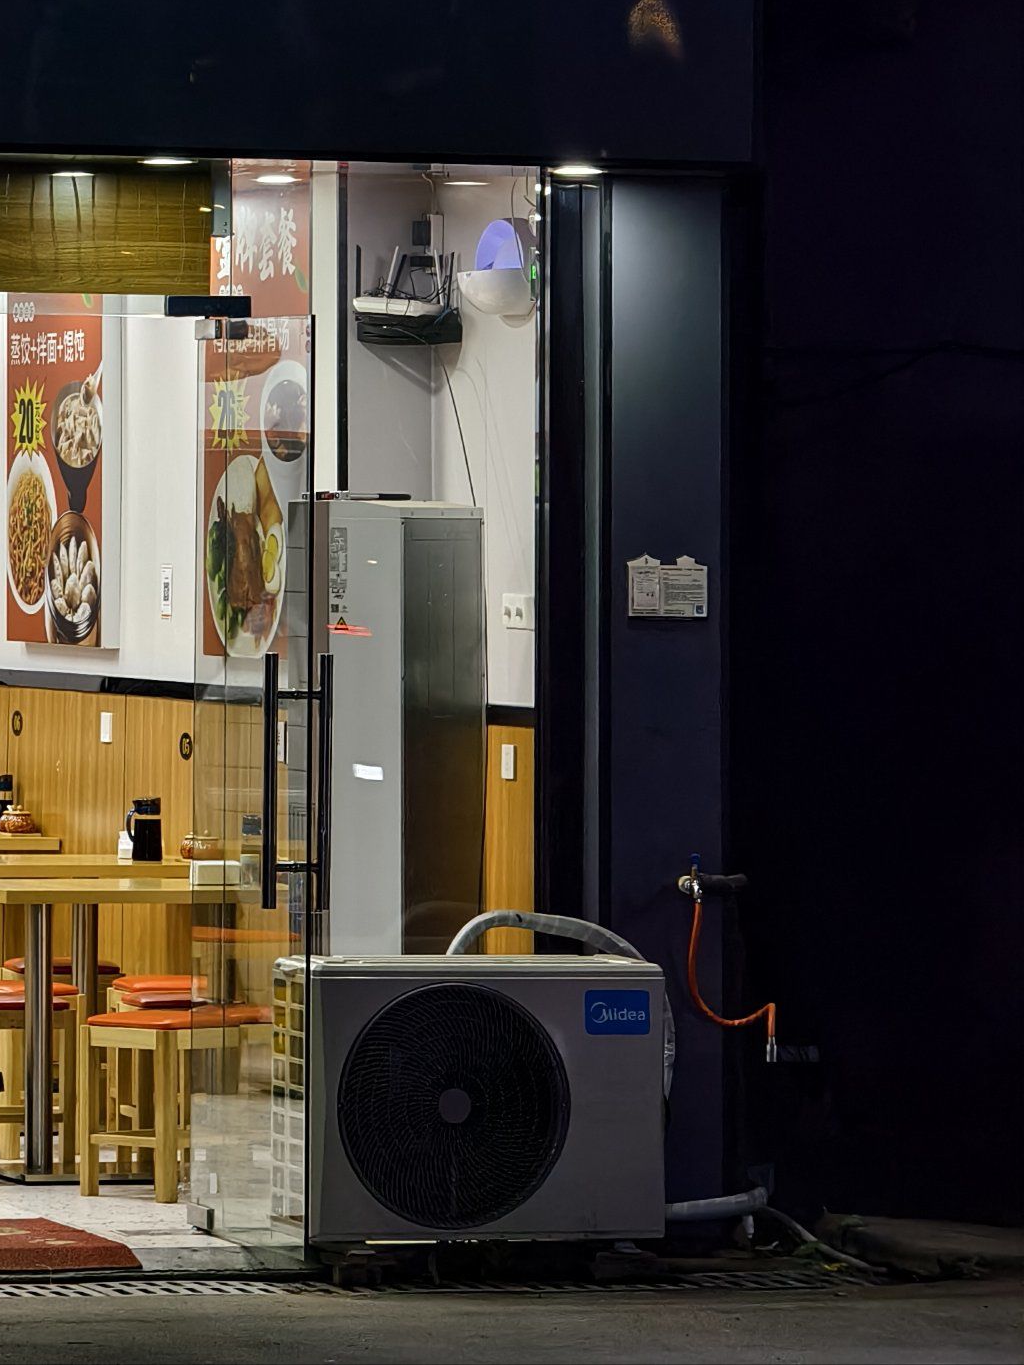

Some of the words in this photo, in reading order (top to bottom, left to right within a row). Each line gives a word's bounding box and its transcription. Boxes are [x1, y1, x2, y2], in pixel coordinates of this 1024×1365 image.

[10, 329, 85, 365] 蒸饺+拌面+馄饨
[18, 398, 34, 445] 20
[217, 390, 236, 440] 26
[590, 1001, 646, 1024] Midea
